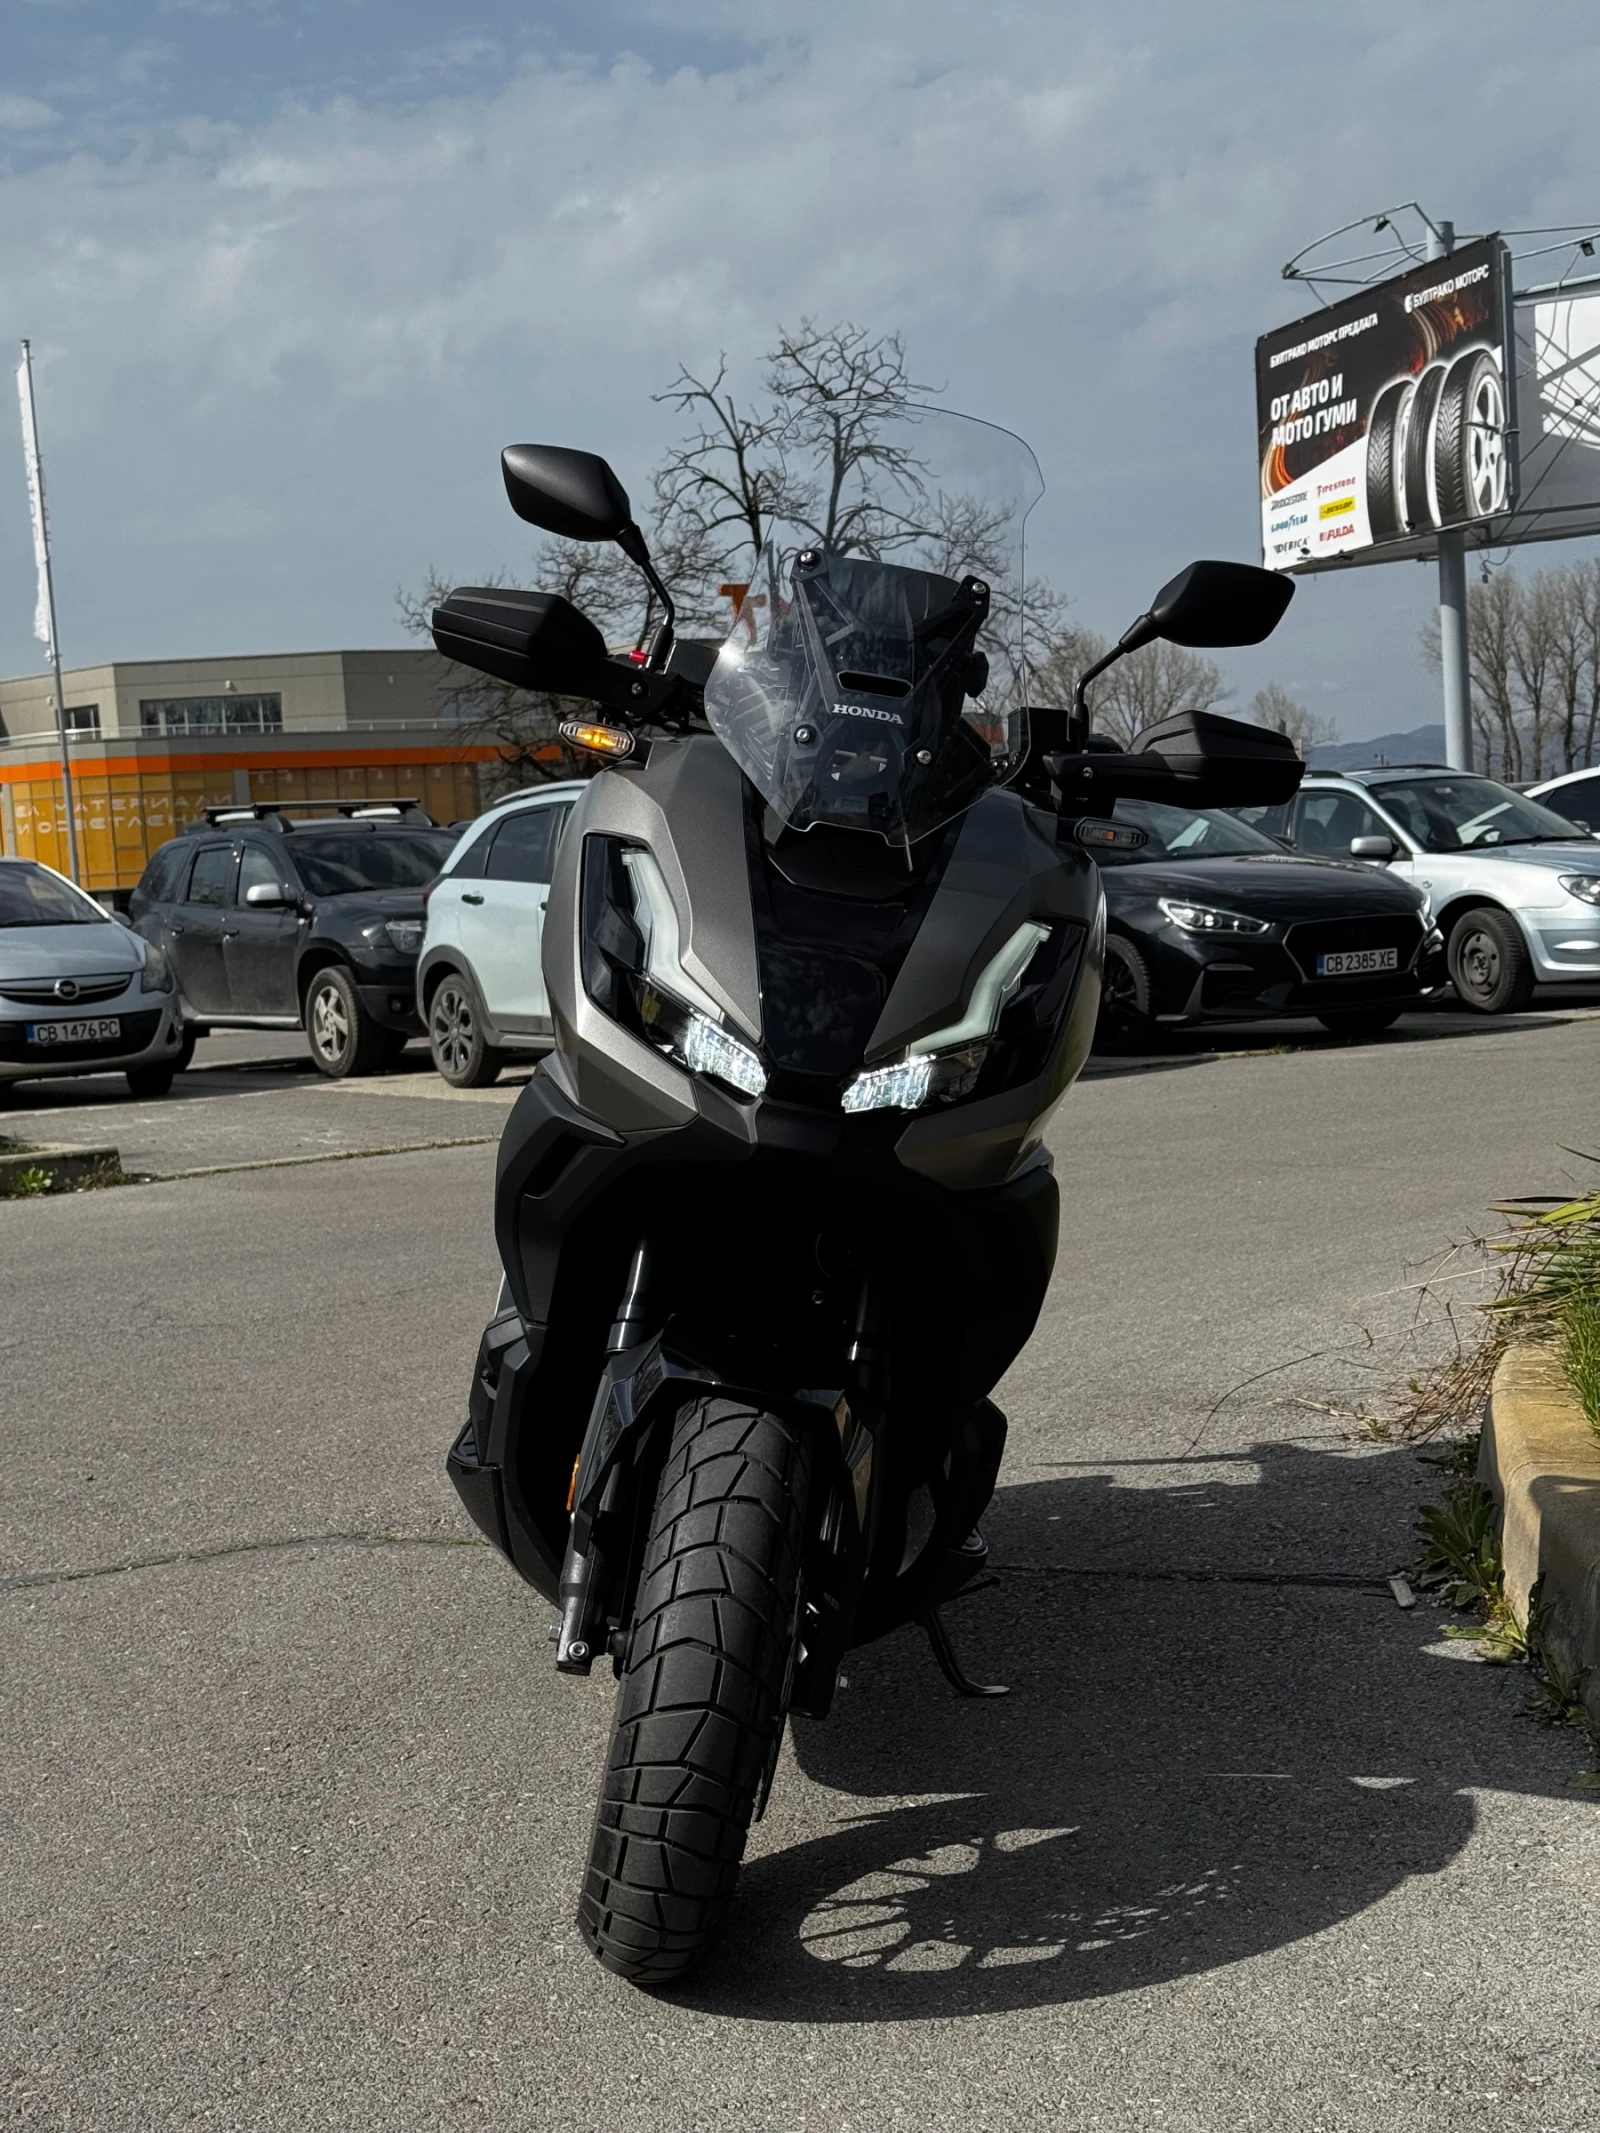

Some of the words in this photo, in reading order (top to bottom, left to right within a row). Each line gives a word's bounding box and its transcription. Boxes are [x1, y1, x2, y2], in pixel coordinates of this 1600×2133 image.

[1413, 279, 1454, 308] БУЛТРАКО
[1455, 264, 1489, 290] МОТОРС
[1269, 342, 1307, 368] БУЛТРАКО
[1307, 329, 1338, 353] МОТОРС
[1338, 312, 1378, 337] ПРЕДЛАГА
[1270, 394, 1290, 421] ОТ
[1291, 379, 1329, 414] АВТО
[1331, 373, 1343, 399] И
[1272, 415, 1313, 447] МОТО
[1315, 398, 1357, 435] ГУМИ
[1324, 501, 1353, 514] DUNLOP
[1327, 524, 1355, 540] FULDA
[832, 704, 904, 725] HONDA
[1326, 956, 1343, 972] CB
[1346, 952, 1376, 971] 2385
[1379, 950, 1395, 967] XE
[37, 1026, 58, 1042] CB
[62, 1023, 97, 1039] 1476
[99, 1020, 118, 1036] PC
